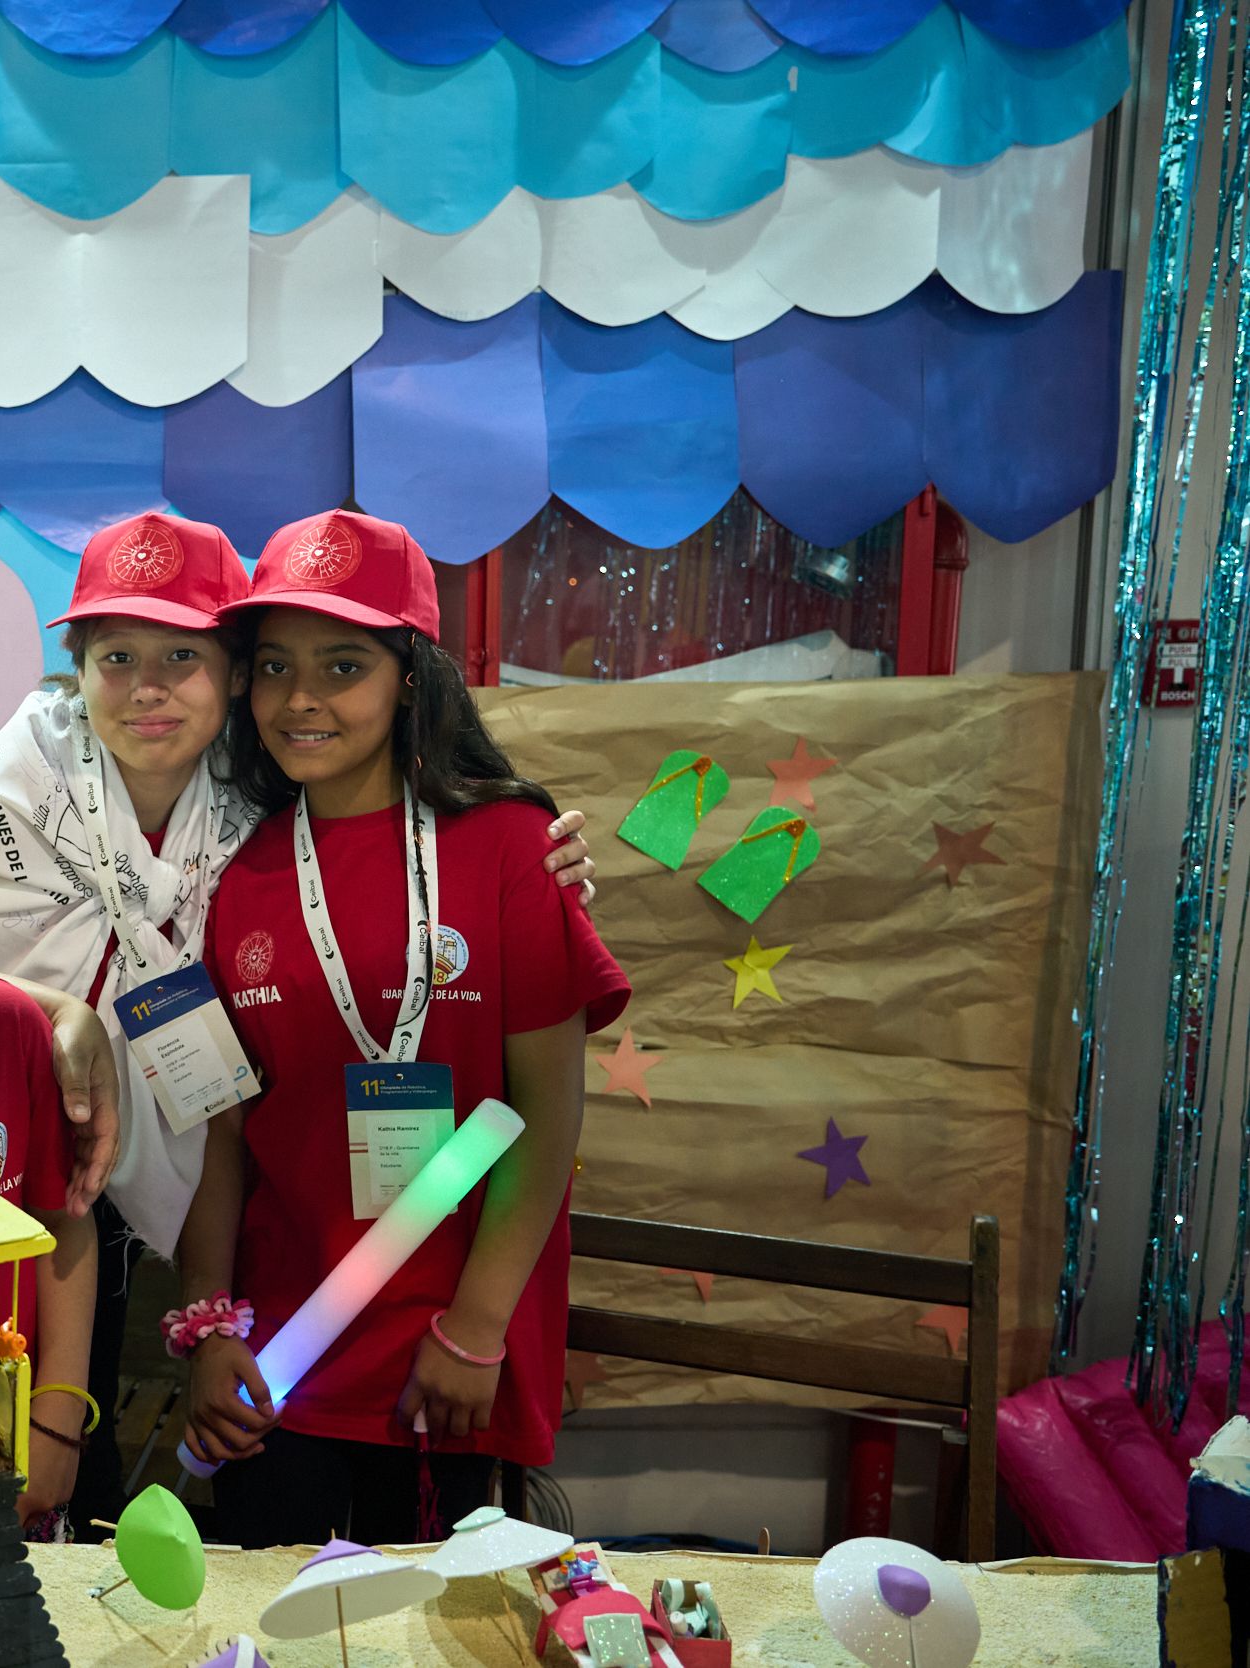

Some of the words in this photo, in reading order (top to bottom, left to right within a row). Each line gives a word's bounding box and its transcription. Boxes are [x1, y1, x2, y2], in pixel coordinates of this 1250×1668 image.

[1160, 690, 1195, 701] BOSCH
[83, 736, 91, 758] Ceibal
[88, 782, 96, 808] Ceibal
[96, 834, 107, 860] Ceibal
[5, 850, 25, 872] DE
[53, 853, 94, 899] Scratch
[108, 886, 121, 913] Ceibal
[309, 879, 317, 902] Ceibal
[125, 938, 142, 963] Ceibal
[318, 927, 331, 952] Ceibal
[419, 927, 427, 954] Ceibal
[232, 985, 282, 1009] KATHIA
[336, 978, 348, 1003] Ceibal
[382, 989, 434, 999] GUARS
[436, 990, 446, 999] DE
[448, 990, 458, 999] LA
[460, 991, 482, 1002] VIDA
[410, 984, 422, 1011] Ceibal
[397, 1038, 409, 1062] Ceiba
[3, 1178, 14, 1191] LA
